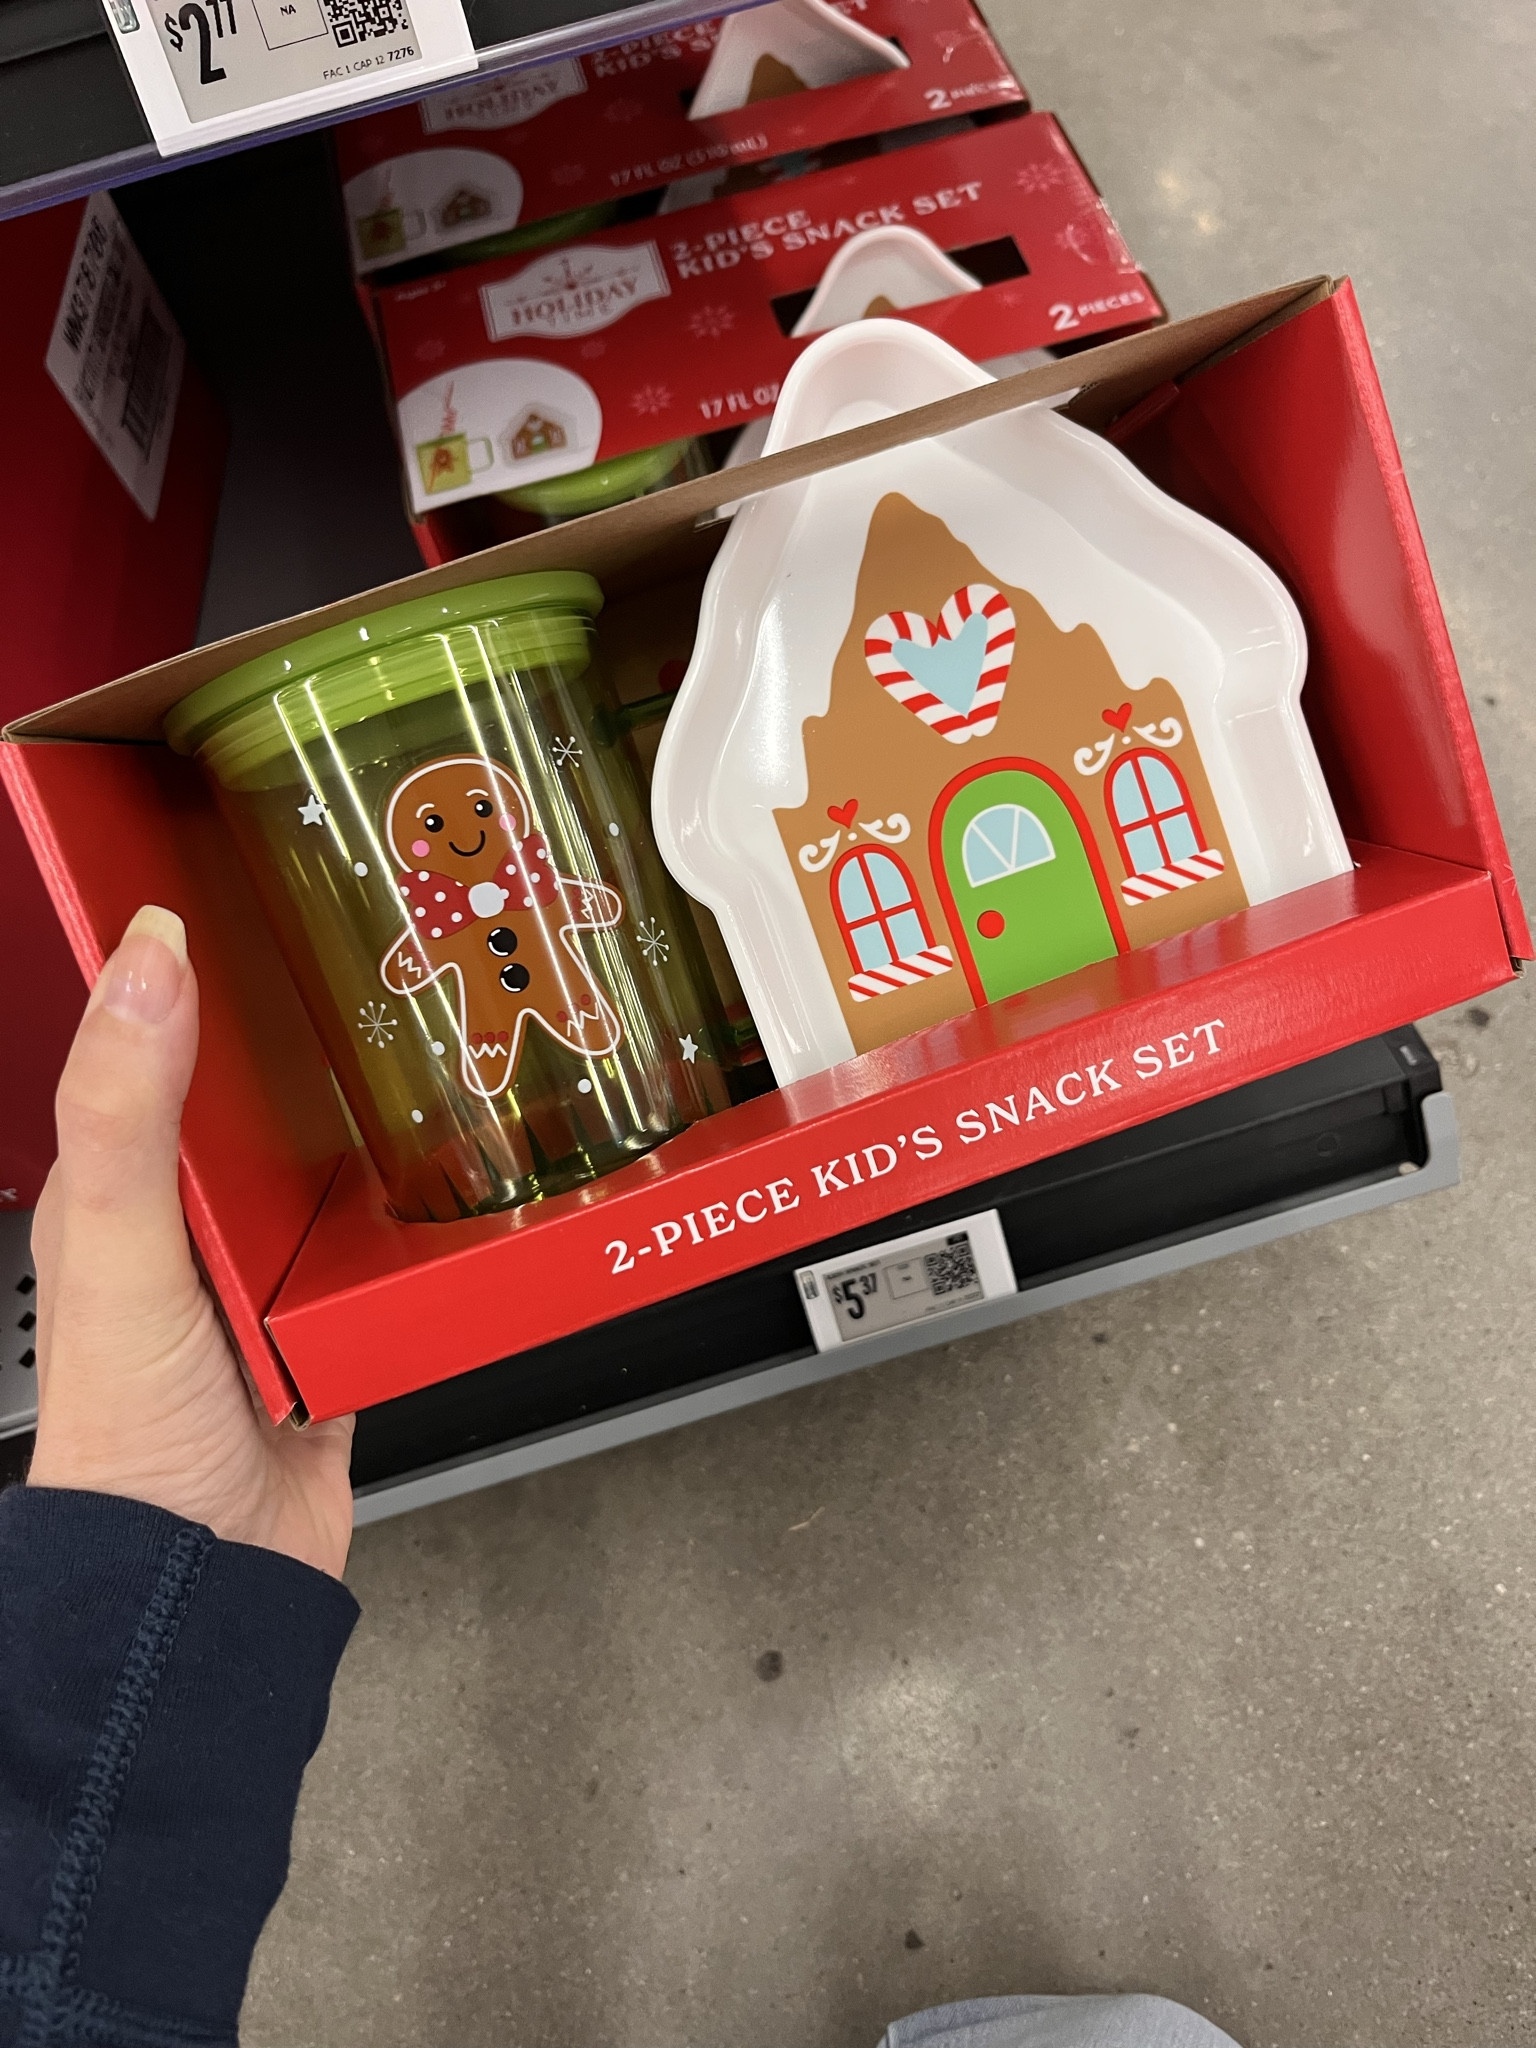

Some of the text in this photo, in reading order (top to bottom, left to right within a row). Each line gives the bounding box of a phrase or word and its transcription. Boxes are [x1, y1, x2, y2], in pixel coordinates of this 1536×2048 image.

[279, 4, 297, 16] NA
[323, 66, 343, 80] FAC
[353, 58, 372, 71] CAP
[375, 55, 385, 65] 12
[387, 46, 415, 61] 7276
[923, 87, 953, 111] 2
[672, 209, 812, 262] 2-PIECE
[676, 181, 983, 280] KID'S SNACK SET
[1048, 289, 1146, 332] 2 PIECES
[699, 397, 724, 420] 17
[726, 389, 753, 414] FL
[605, 1018, 1226, 1275] 2-PIECE KID'S SNACK SET
